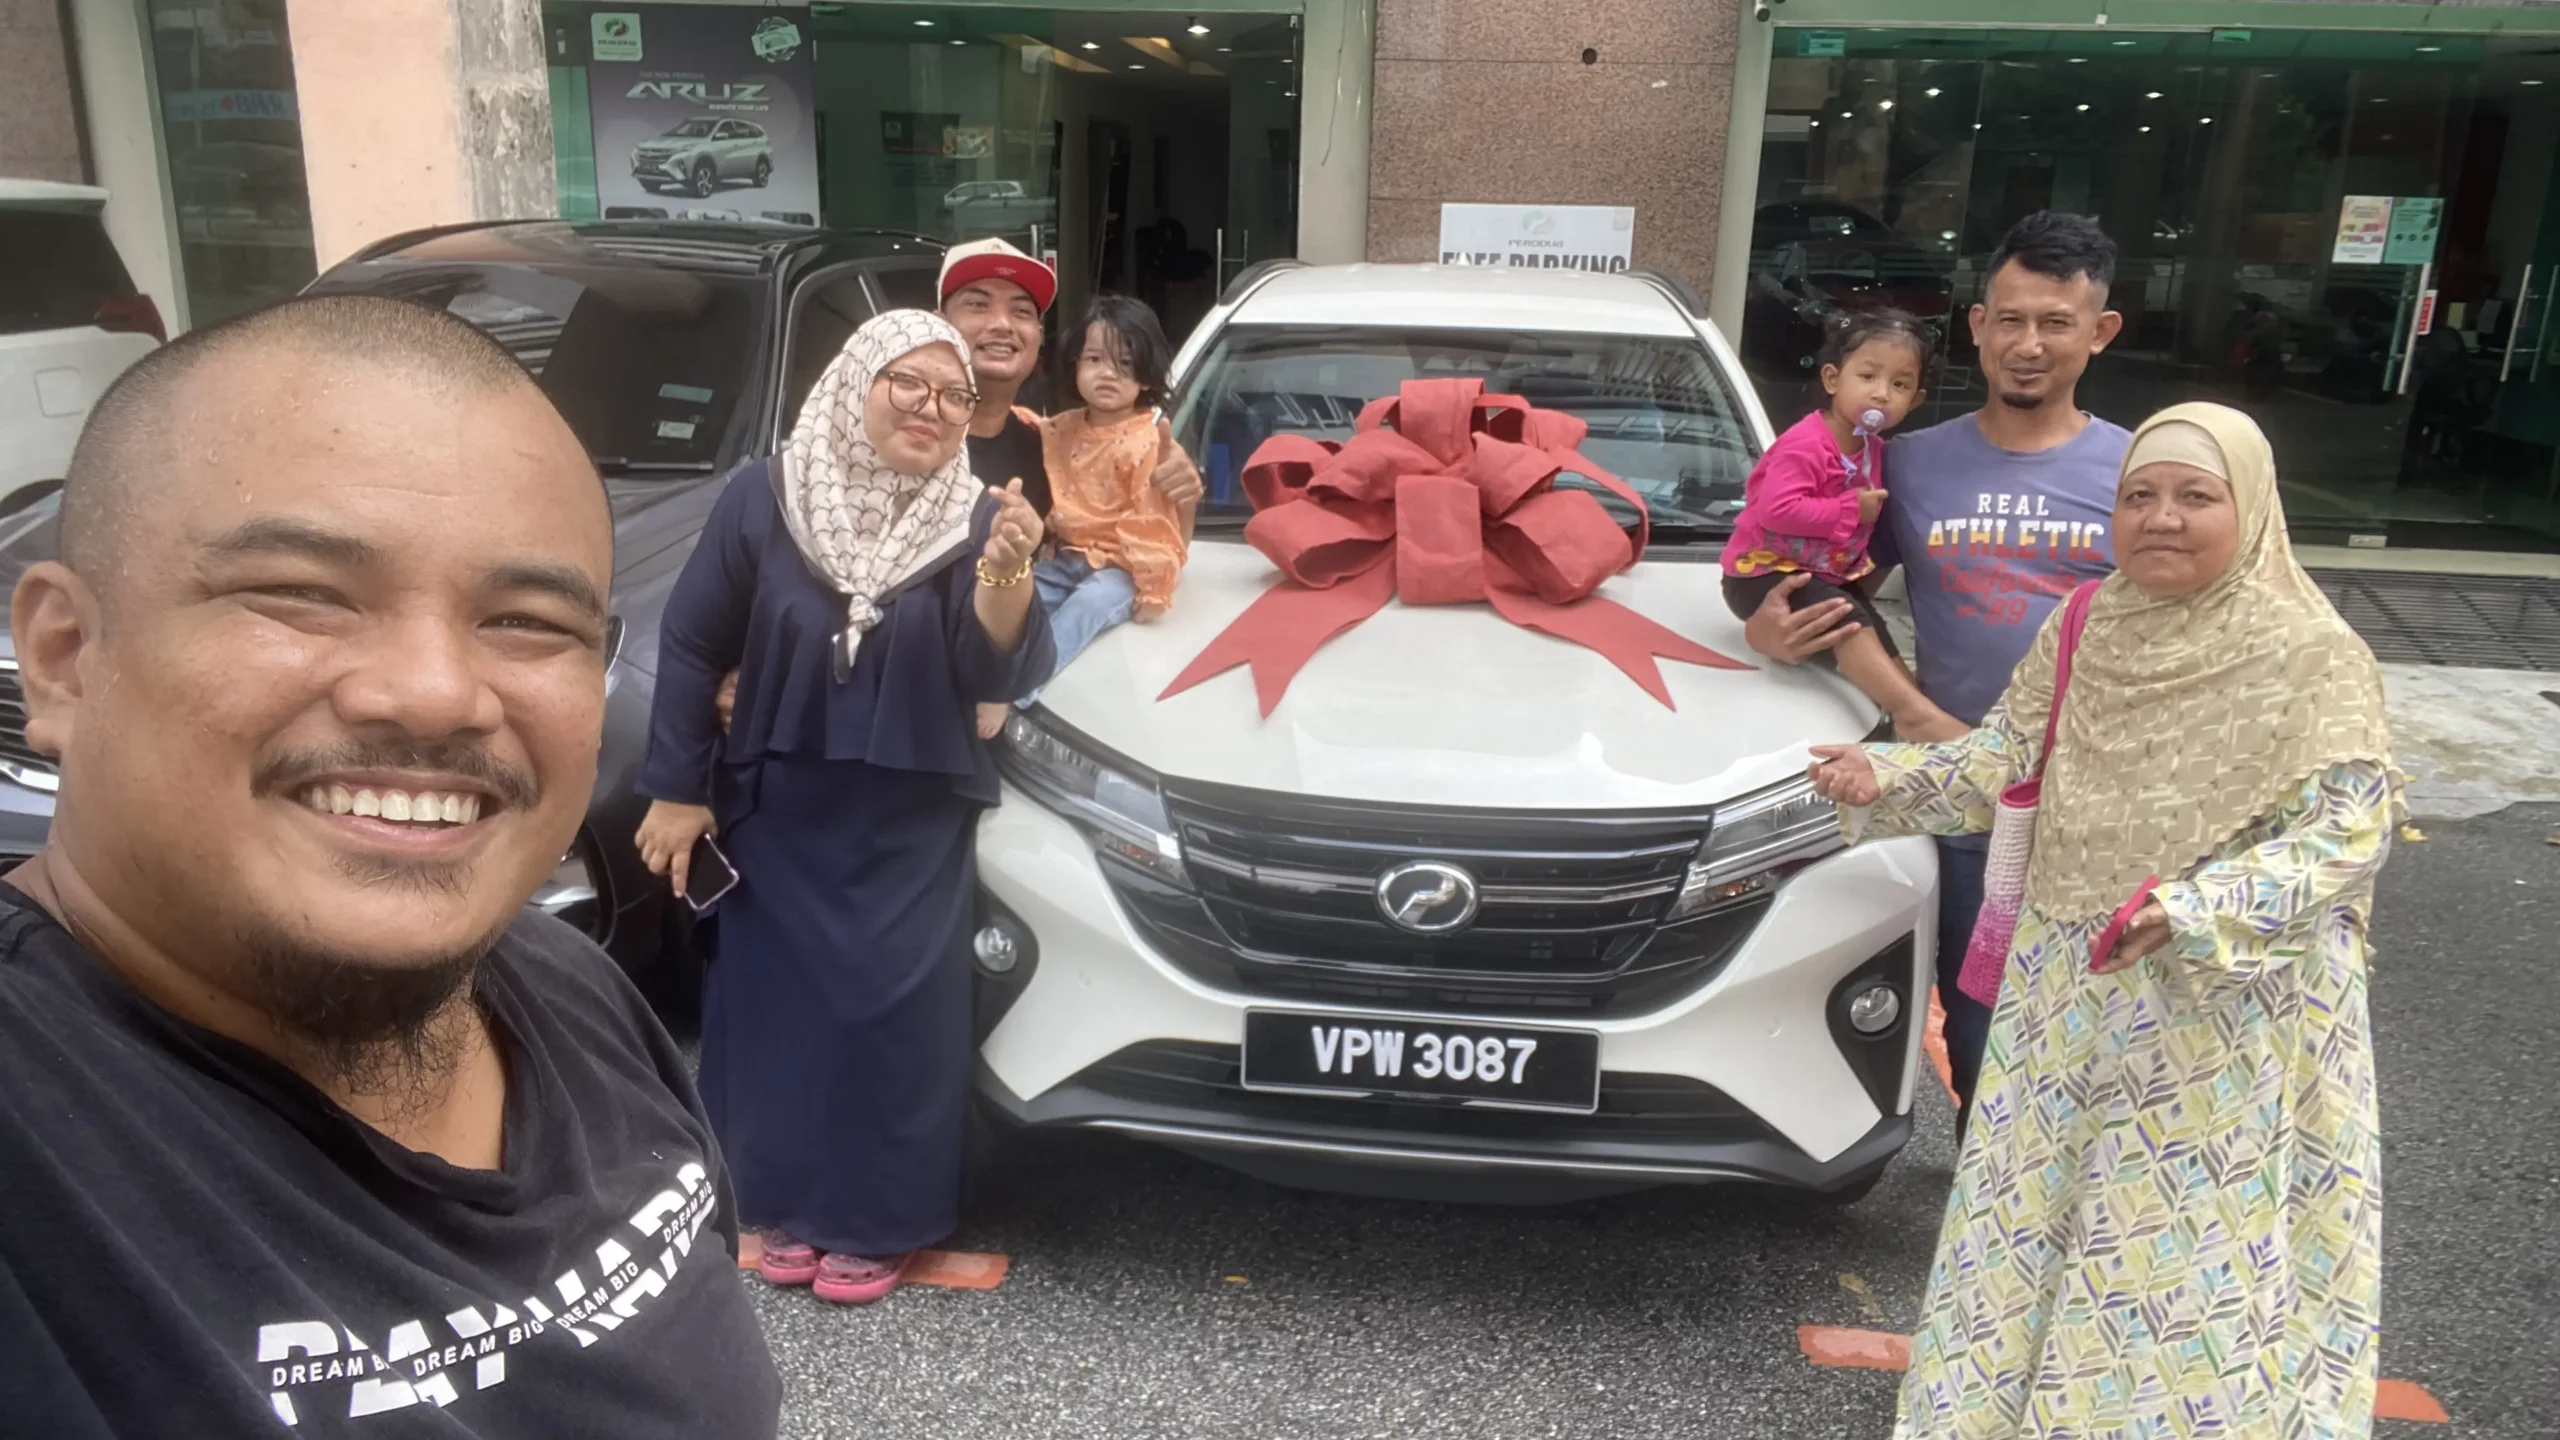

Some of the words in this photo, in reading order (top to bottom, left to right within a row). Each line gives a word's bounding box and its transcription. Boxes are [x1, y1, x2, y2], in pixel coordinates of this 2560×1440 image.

[625, 81, 772, 105] ARUZ
[1442, 252, 1501, 266] FEE
[1977, 493, 2050, 516] REAL
[1927, 518, 2105, 561] ATHLETIC
[1311, 1026, 1405, 1077] VPW
[1412, 1033, 1537, 1084] 3087
[662, 1197, 698, 1244] DREAM
[699, 1181, 712, 1204] BIG
[556, 1286, 609, 1328] DREAM
[610, 1261, 639, 1291] BIG
[413, 1335, 496, 1377] DREAM
[508, 1320, 545, 1345] BIG
[272, 1356, 364, 1387] DREAM
